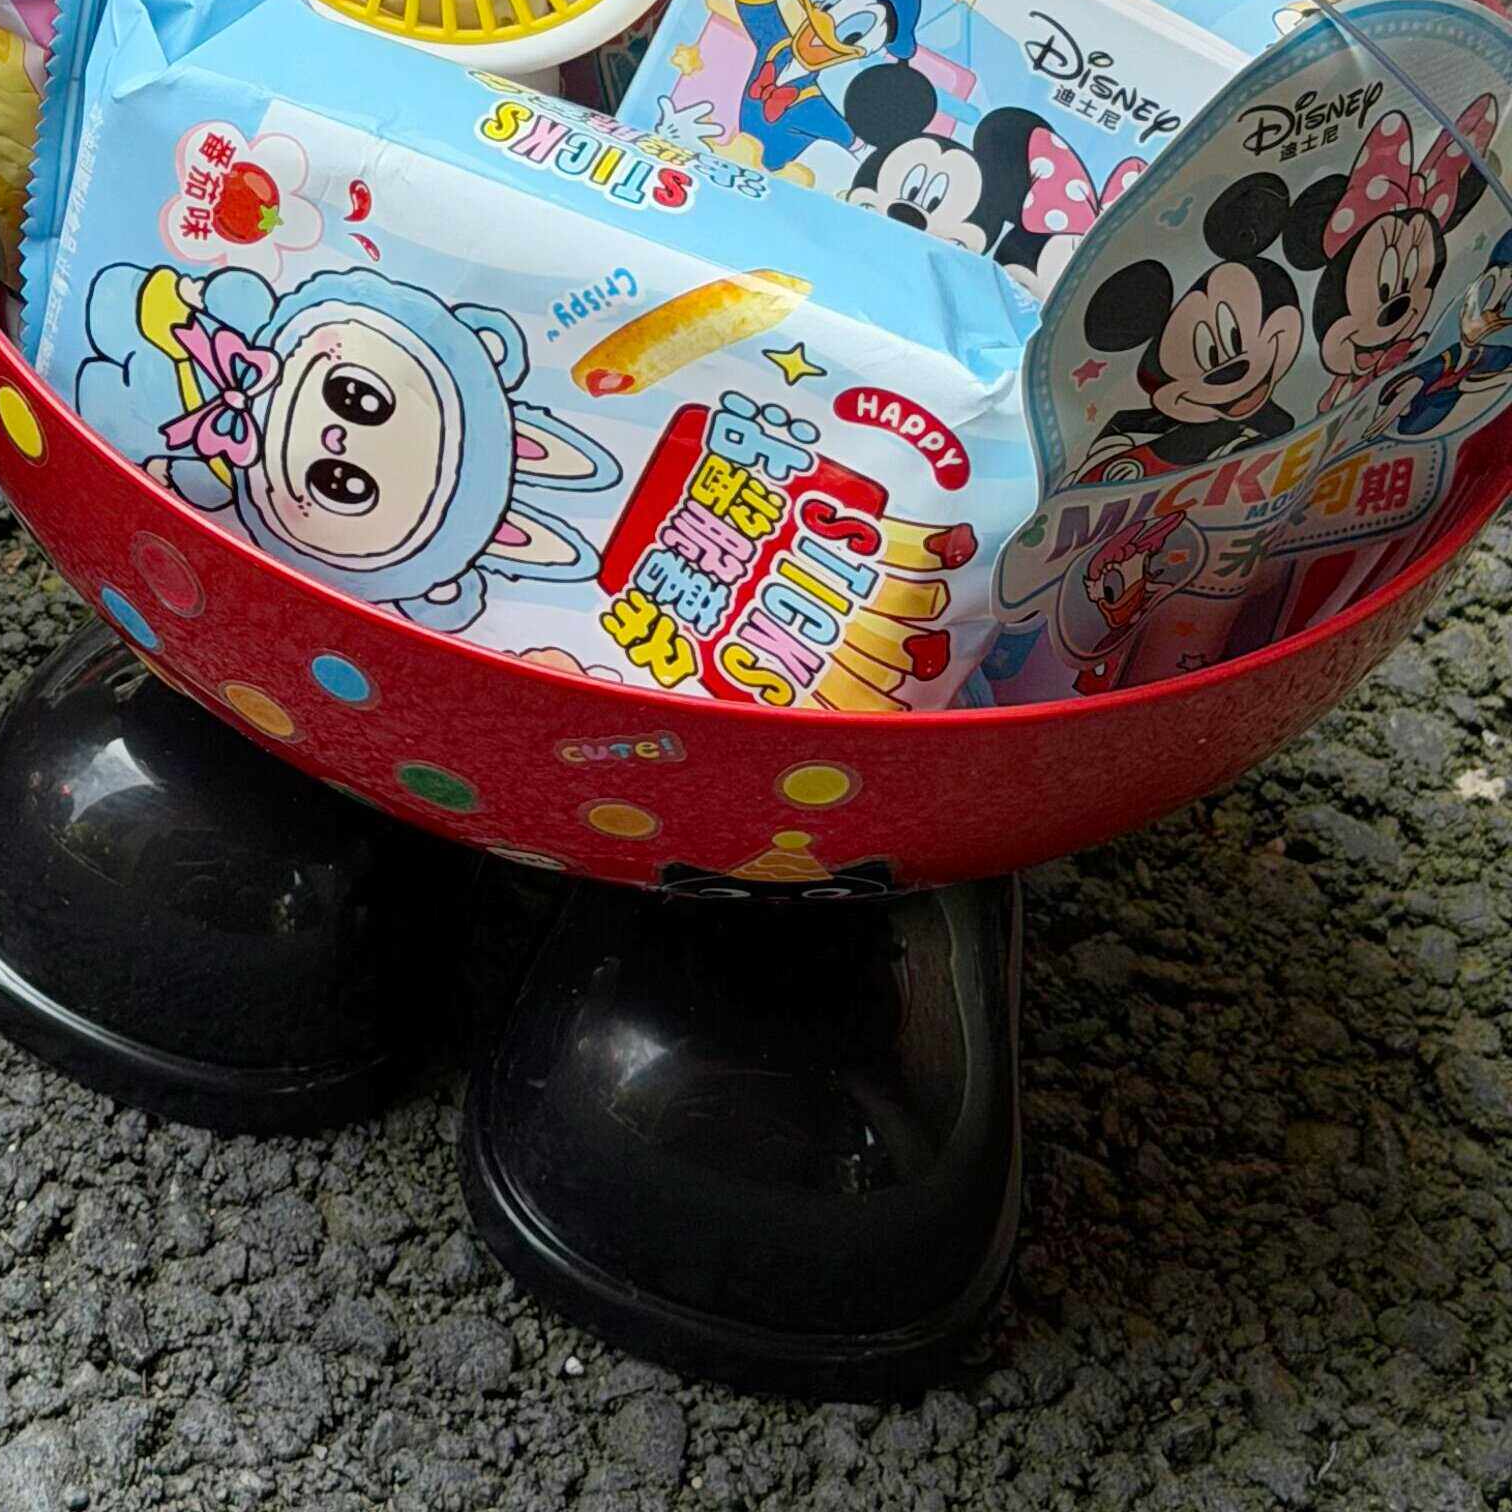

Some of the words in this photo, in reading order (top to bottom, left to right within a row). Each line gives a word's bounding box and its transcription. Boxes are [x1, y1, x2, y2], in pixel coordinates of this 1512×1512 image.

[482, 98, 694, 208] STICKS
[1051, 83, 1123, 131] 迪士尼
[1279, 128, 1340, 162] 迪士尼
[179, 130, 235, 242] 番茄味
[857, 392, 964, 470] HAPPY
[718, 496, 884, 706] STICKS
